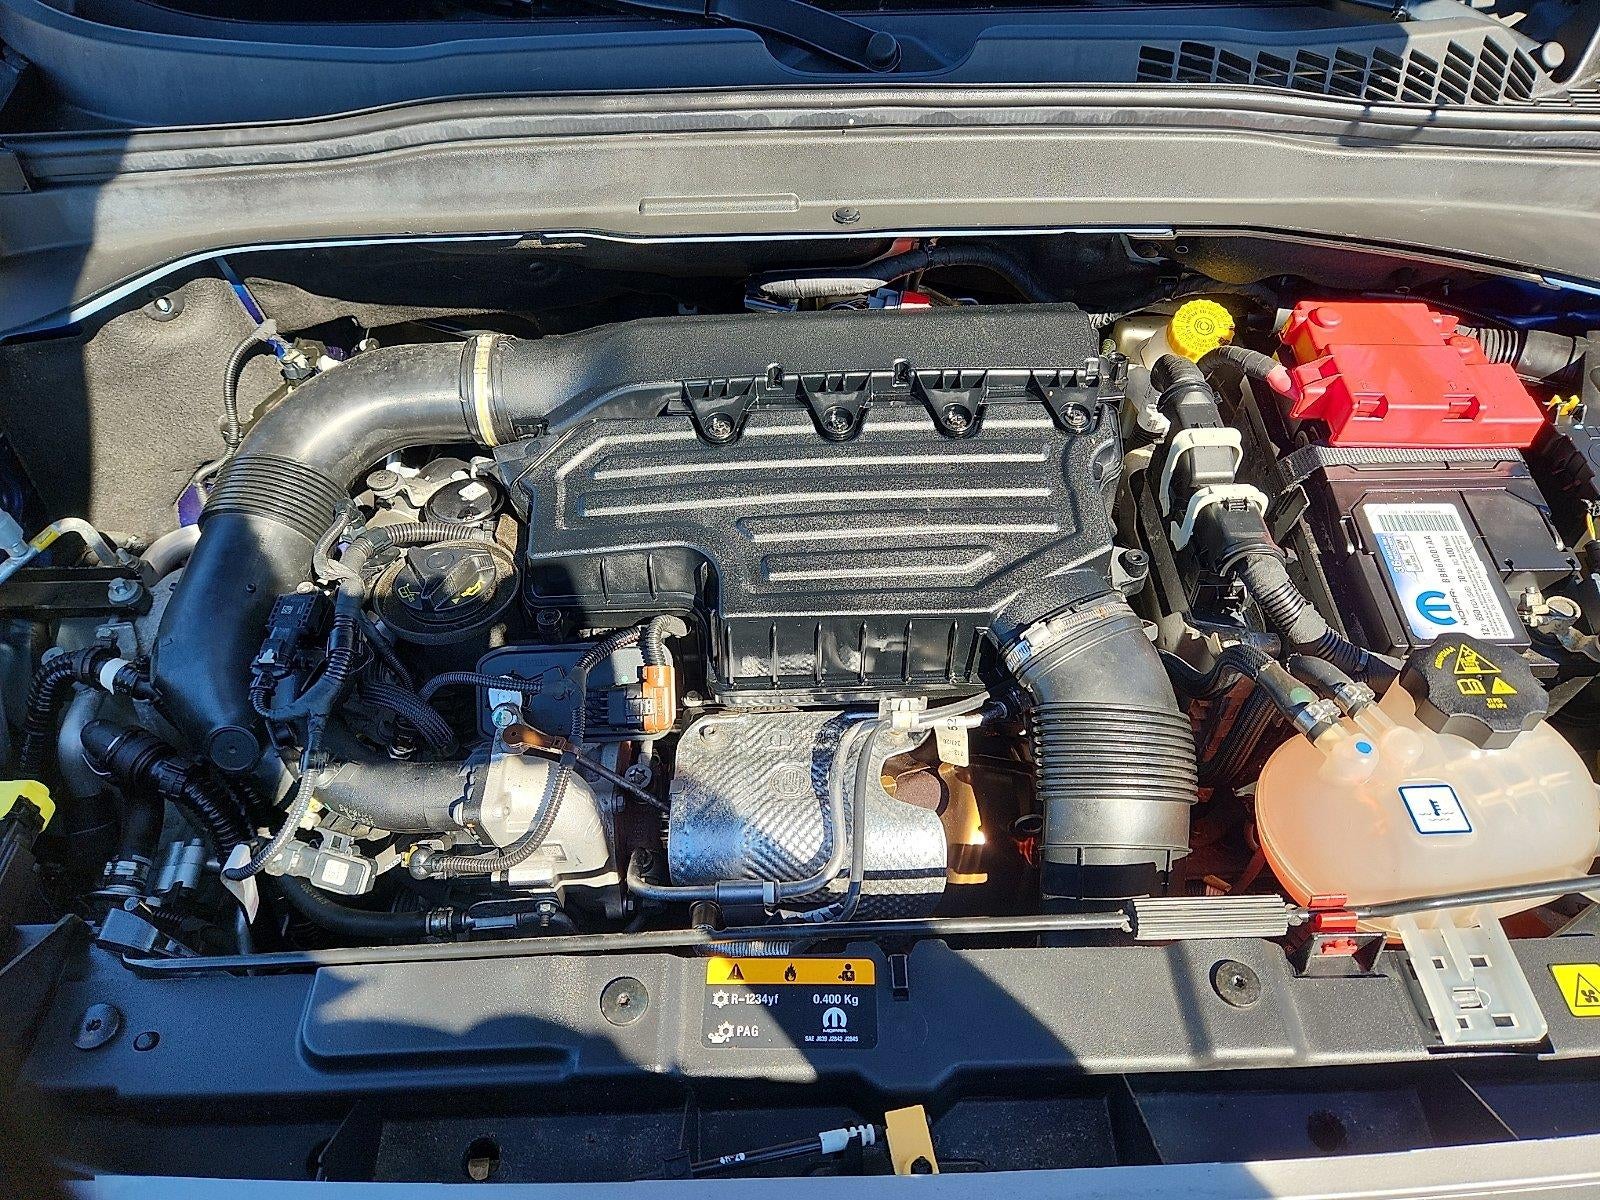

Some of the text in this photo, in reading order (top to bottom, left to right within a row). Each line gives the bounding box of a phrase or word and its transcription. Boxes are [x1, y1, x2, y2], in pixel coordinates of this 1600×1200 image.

[1449, 591, 1469, 625] MOPAR
[731, 993, 859, 1007] R-1234yf 0.400 Kg
[737, 1025, 759, 1037] PAG
